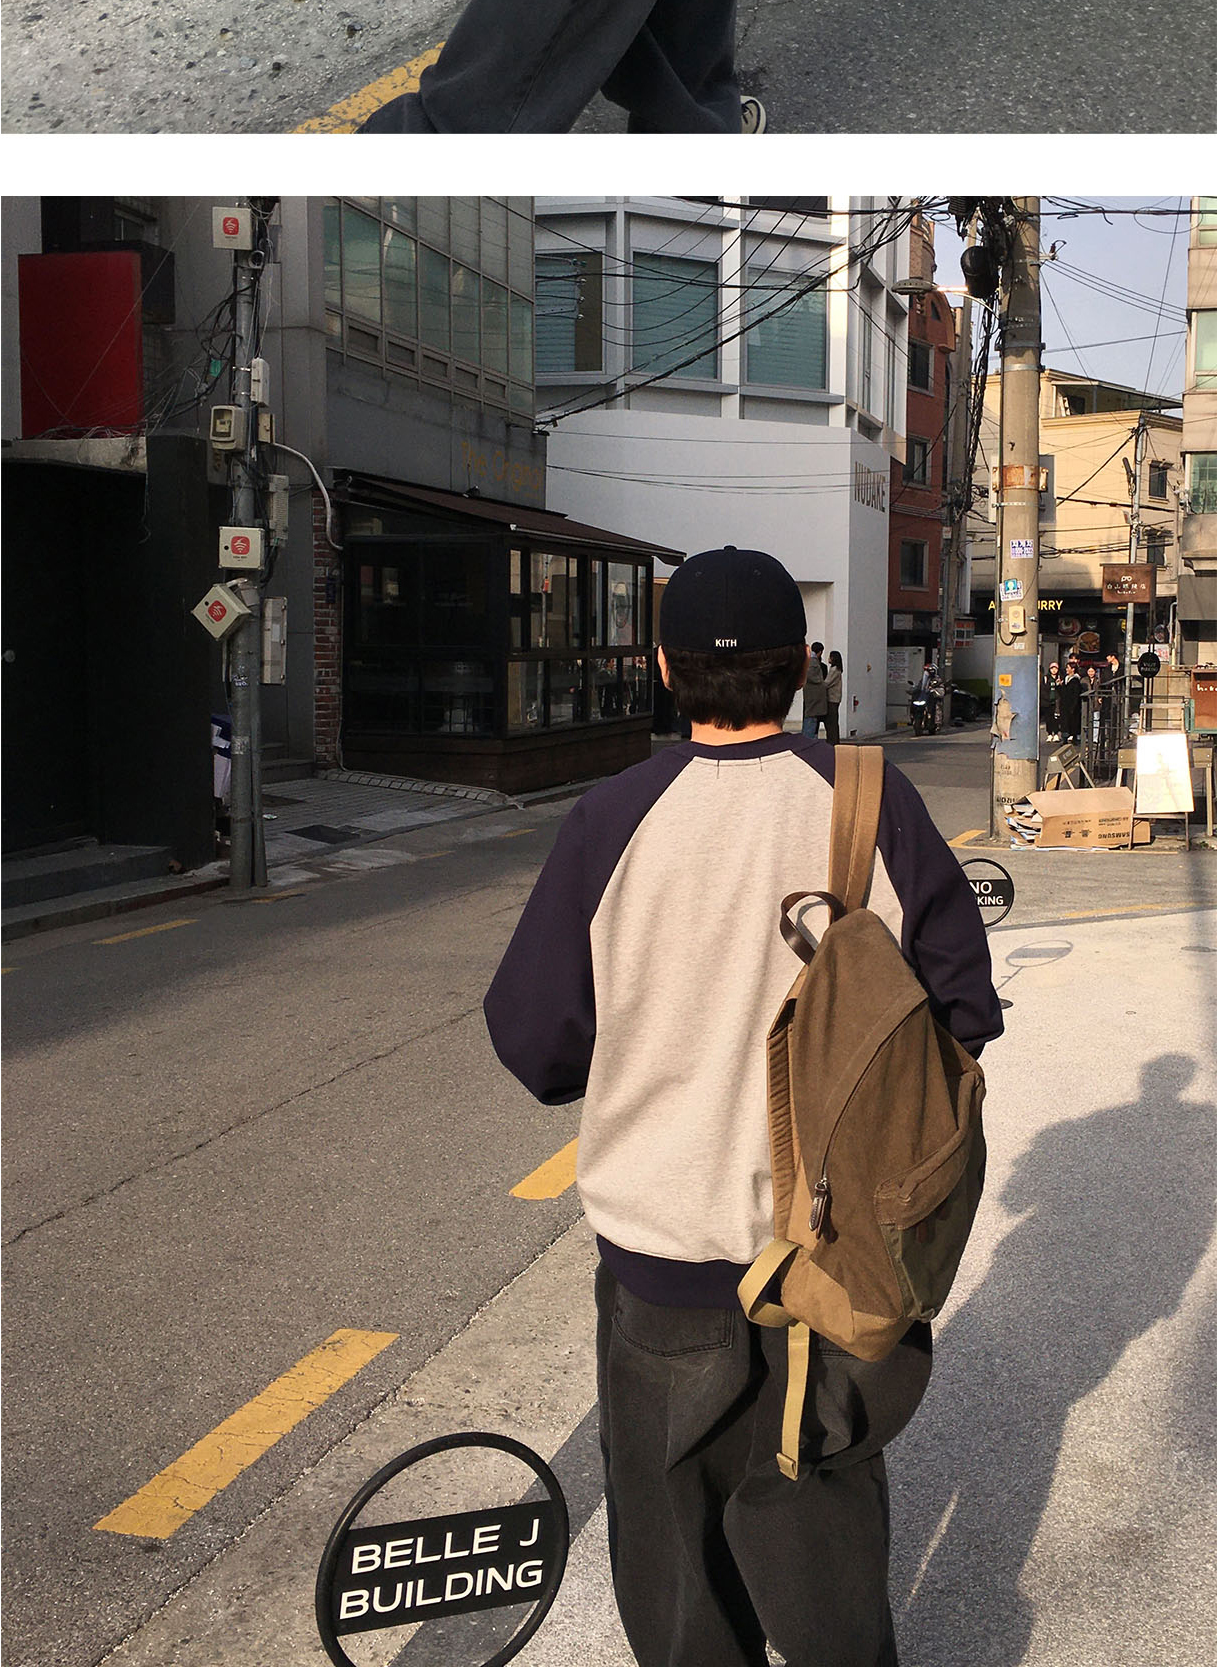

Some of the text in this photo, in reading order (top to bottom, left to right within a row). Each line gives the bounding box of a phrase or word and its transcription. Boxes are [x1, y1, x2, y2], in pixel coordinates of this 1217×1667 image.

[854, 461, 885, 513] NUDAKE
[715, 638, 737, 647] KITH
[1098, 831, 1131, 840] SAMSUNG
[977, 896, 1004, 905] KING
[351, 1518, 540, 1575] BELLE J
[339, 1559, 544, 1620] BUILDING
